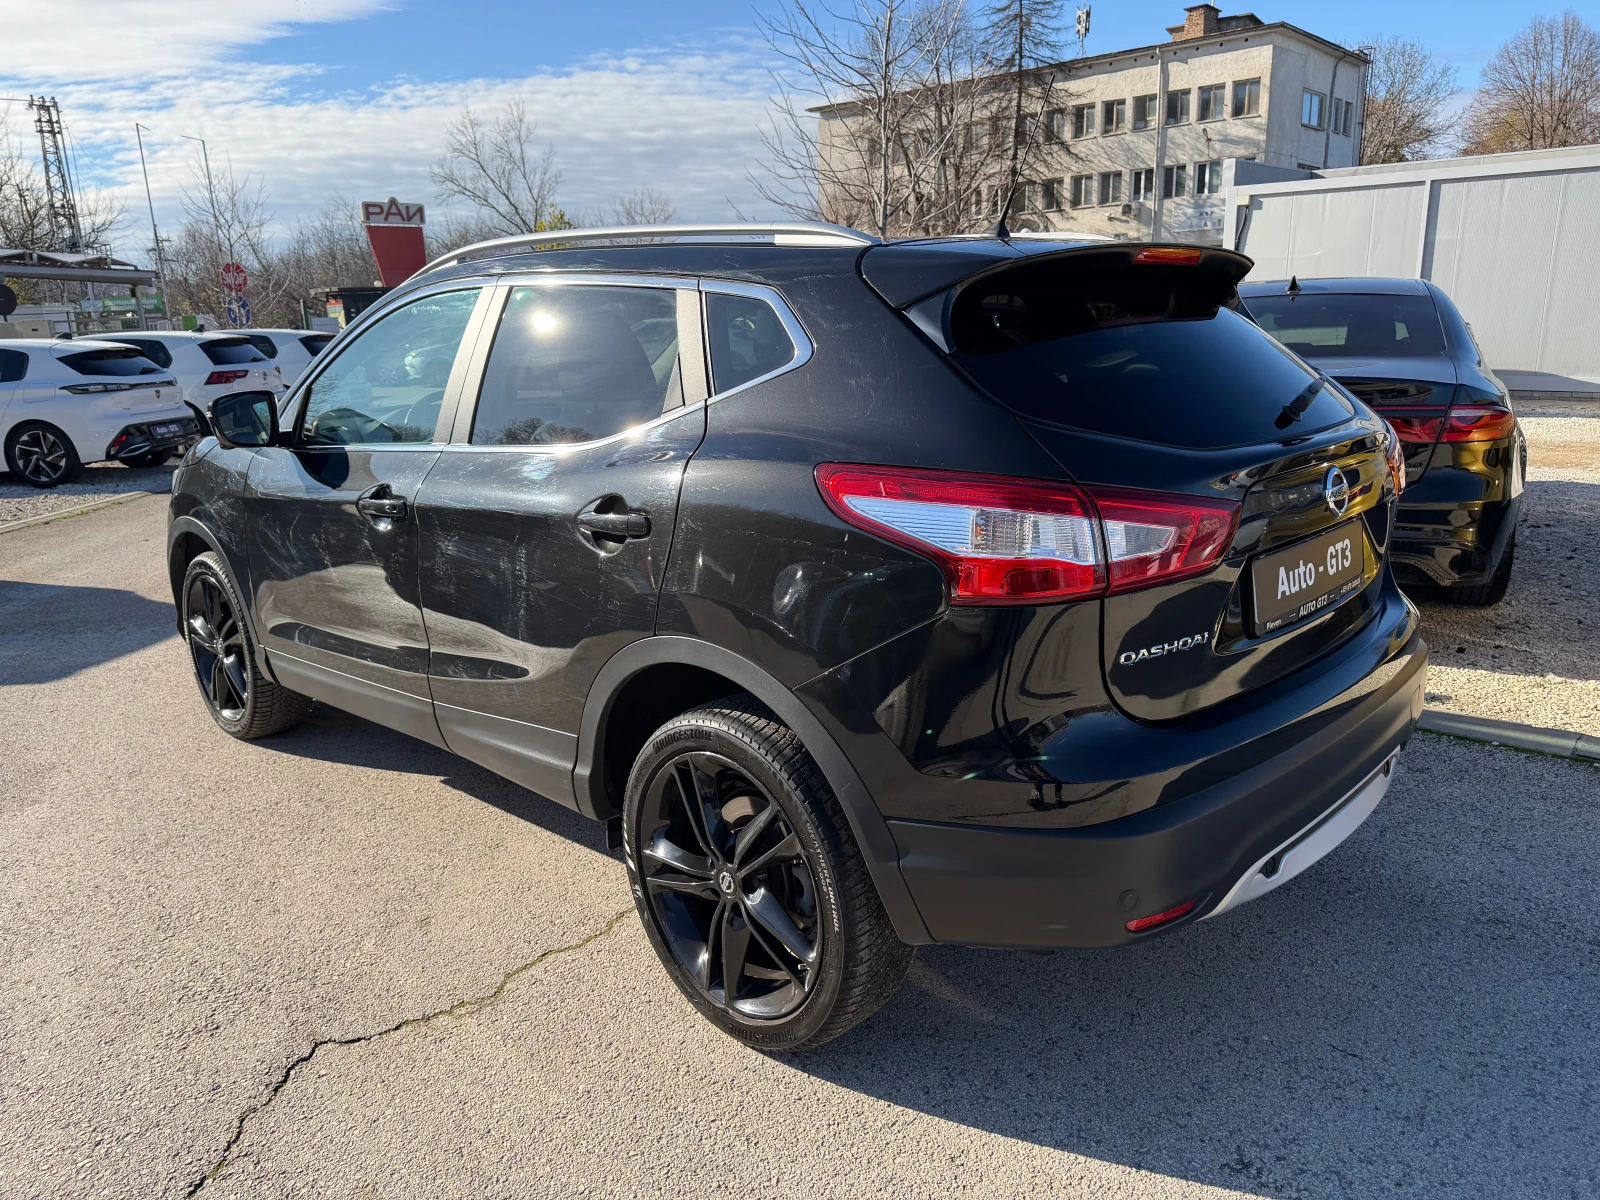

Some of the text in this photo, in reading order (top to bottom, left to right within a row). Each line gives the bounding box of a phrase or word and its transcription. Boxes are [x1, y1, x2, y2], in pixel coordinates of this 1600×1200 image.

[1277, 560, 1315, 599] Auto
[1327, 538, 1351, 575] GT3
[1266, 594, 1328, 630] Pleven AUTO GT3
[1119, 631, 1208, 665] QASHQAI
[652, 729, 714, 755] BRIDGESTONE
